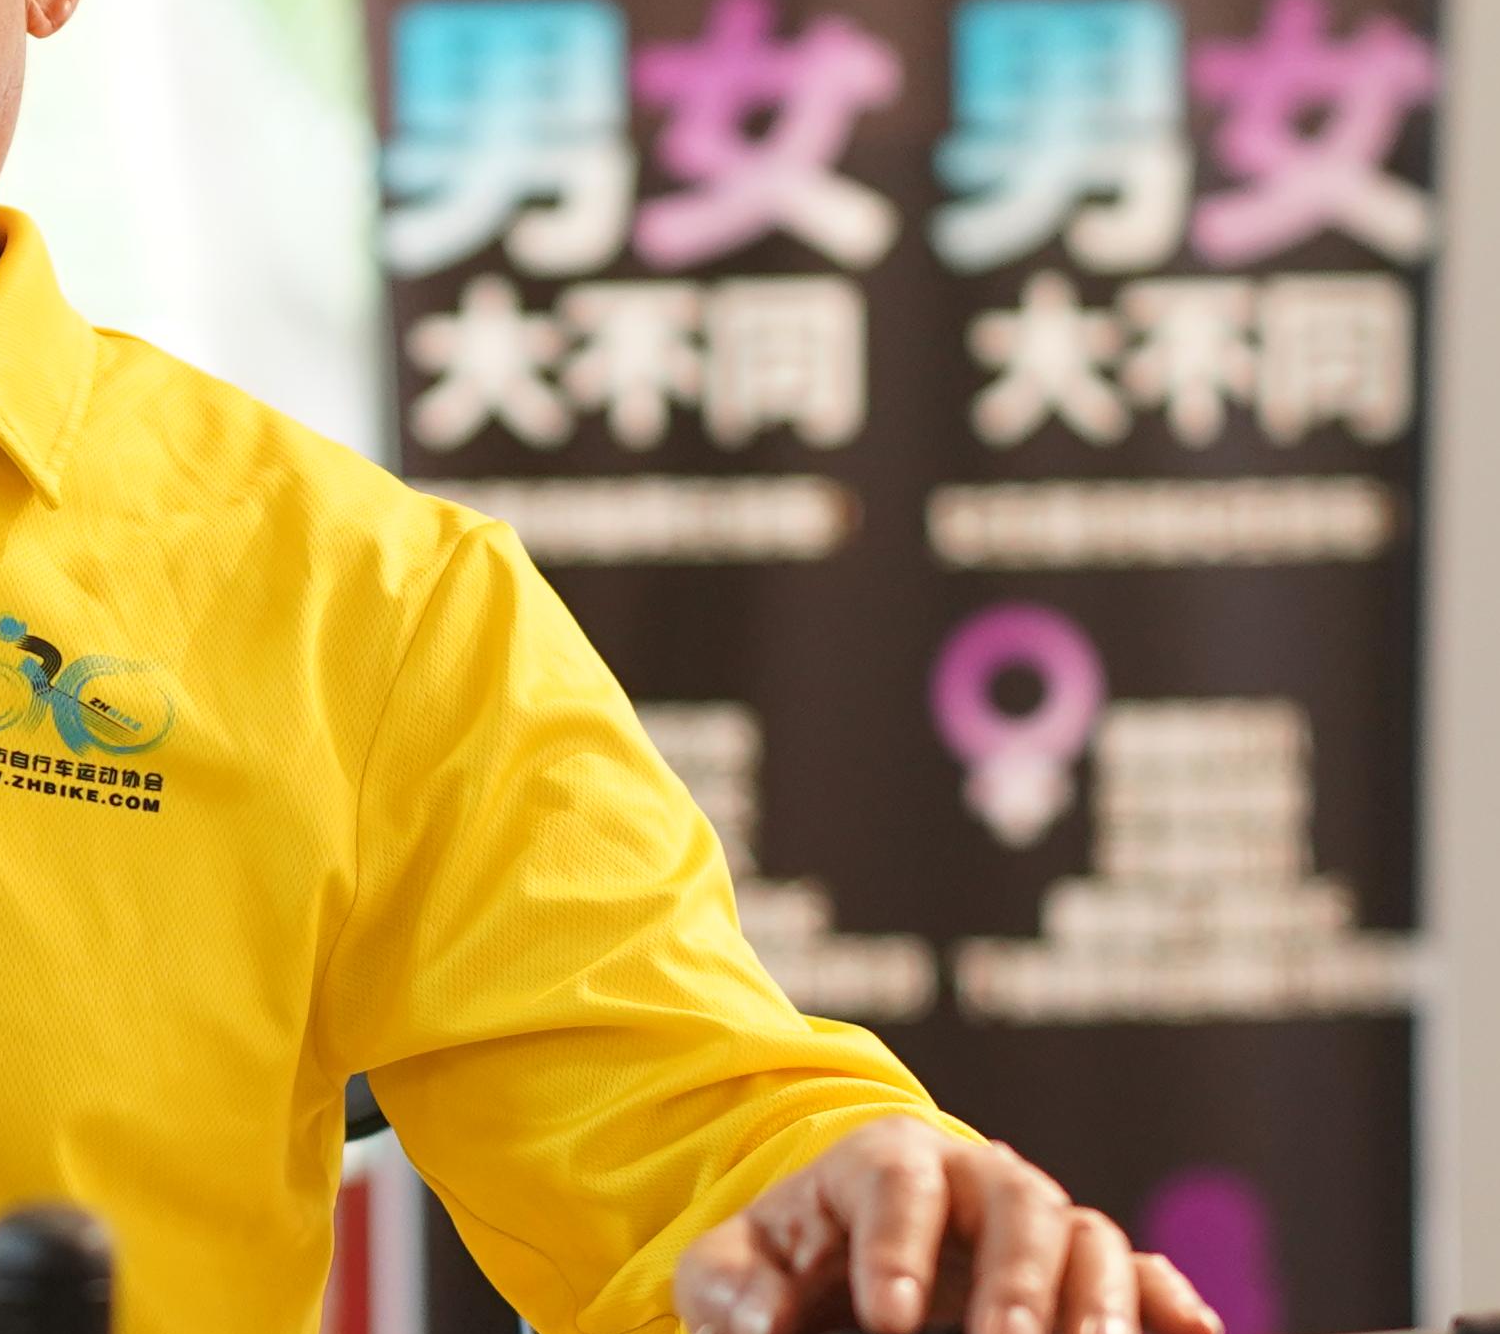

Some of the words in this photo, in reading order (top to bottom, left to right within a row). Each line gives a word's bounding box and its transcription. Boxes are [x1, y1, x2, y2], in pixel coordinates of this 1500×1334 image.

[407, 273, 868, 449] 大不同
[968, 273, 1415, 449] 大不同
